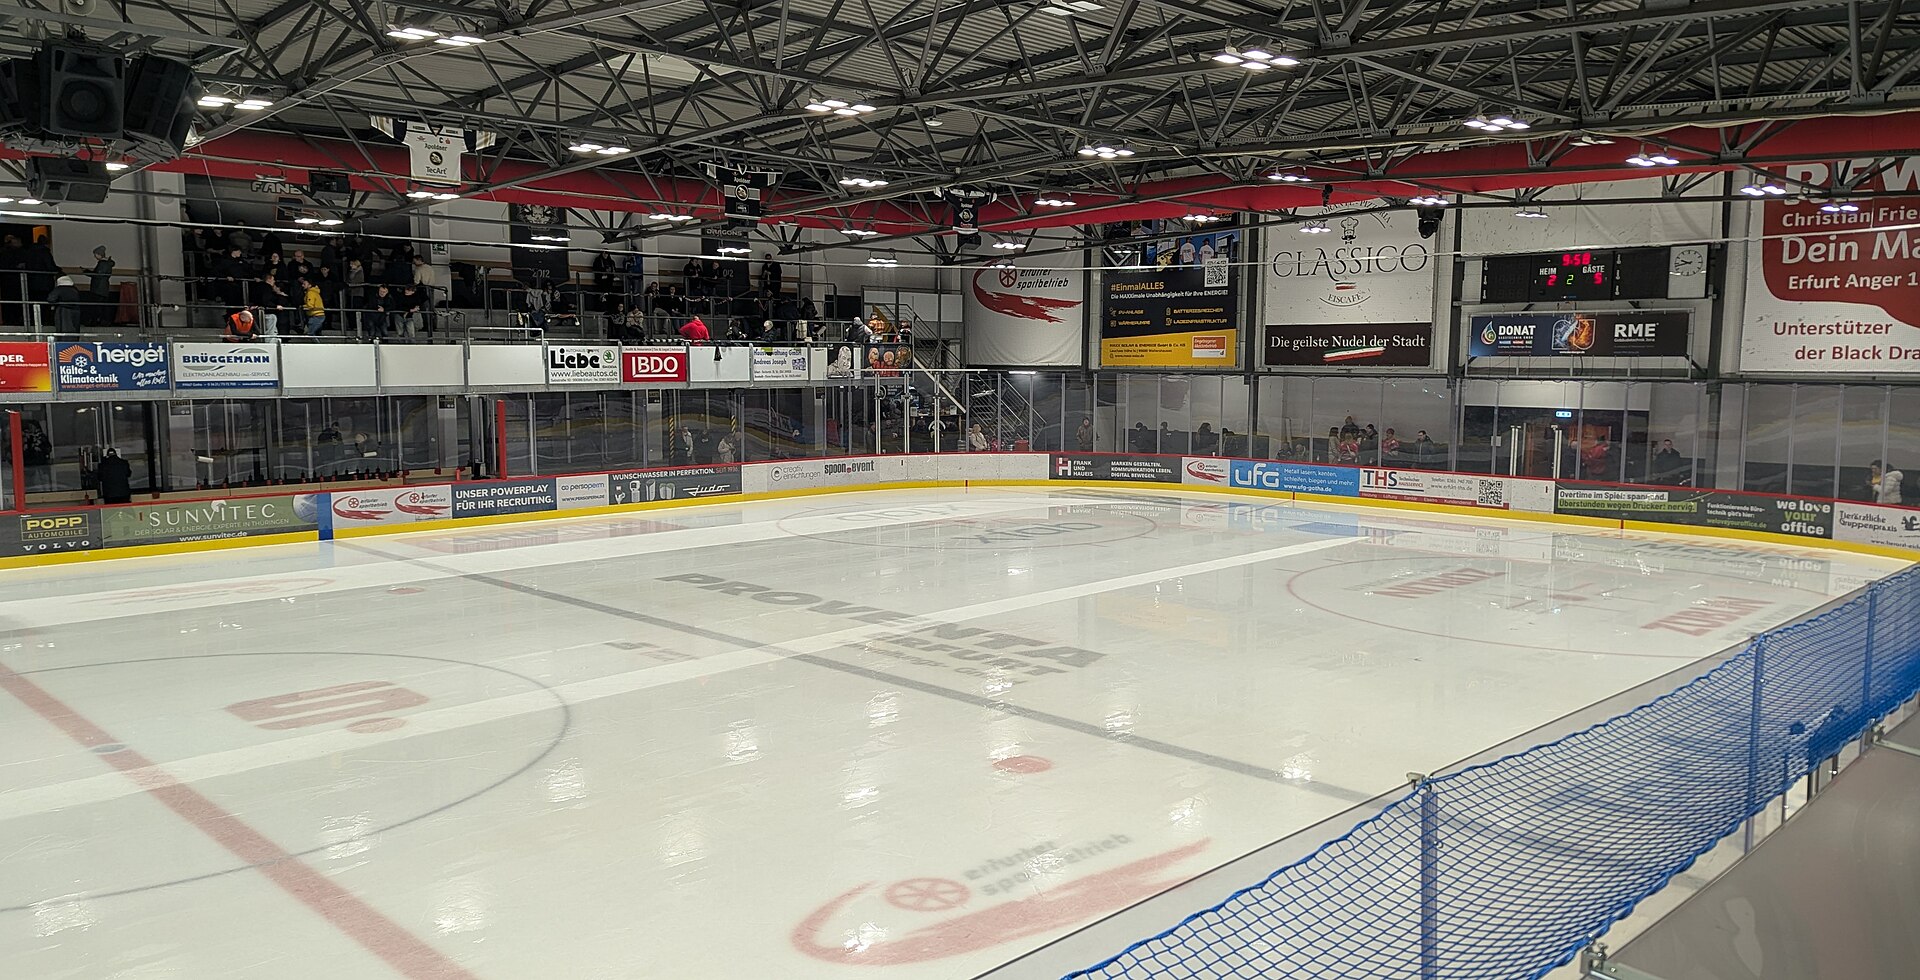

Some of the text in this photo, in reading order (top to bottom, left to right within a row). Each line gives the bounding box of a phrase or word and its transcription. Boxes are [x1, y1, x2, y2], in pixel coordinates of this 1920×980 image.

[1782, 210, 1871, 227] Christian
[1782, 230, 1920, 264] Dein Ma
[1273, 243, 1428, 281] CLASSICO
[1540, 267, 1557, 276] HEIM
[1582, 264, 1605, 274] GÄSTE
[1016, 278, 1069, 290] sportbetrieb
[1547, 275, 1557, 286] 2
[1566, 274, 1574, 284] 2
[1789, 274, 1840, 290] Erfurt
[1845, 273, 1902, 290] Anger
[1110, 282, 1165, 292] #EinmalALLES
[1498, 326, 1536, 336] DONAT
[1614, 324, 1656, 338] RME
[1774, 320, 1893, 336] Unterstützer
[1271, 334, 1426, 351] Die geilste Nudel der Stadt
[97, 343, 165, 367] herget
[182, 352, 270, 363] BRÜGGEMANN
[550, 348, 600, 368] Liebe
[1795, 345, 1920, 360] der Black Dra
[60, 366, 97, 375] Kälte- &
[550, 370, 618, 378] www.liebeautos.de
[60, 374, 119, 384] Klimatechnik
[612, 471, 669, 480] WUNSCHWASSER
[676, 468, 715, 476] PERFEKTION.
[782, 465, 804, 473] creativ
[782, 470, 821, 480] einrichtungen
[1362, 470, 1398, 487] THS
[456, 484, 548, 499] UNSER POWERPLAY
[570, 482, 604, 492] persoperm
[1284, 484, 1332, 492] www.ufg-gotha.de
[456, 495, 554, 510] FÜR IHR RECRUITING.
[1607, 502, 1632, 510] wegen
[1668, 504, 1695, 512] nervig.
[1706, 503, 1750, 512] Funktionierende
[1776, 500, 1830, 514] we love
[149, 503, 276, 527] SUNVITEC
[1784, 510, 1817, 522] your
[1839, 510, 1887, 524] Tierärztliche
[26, 516, 82, 530] POPP
[182, 524, 212, 533] ENERGIE
[213, 522, 242, 531] EXPERTE
[251, 518, 290, 527] THÜRINGEN
[1781, 522, 1825, 536] office
[1840, 518, 1898, 533] Gruppenpraxis
[28, 530, 83, 539] AUTOMOBILE
[179, 530, 248, 542] www.sunvitec.de
[23, 540, 90, 552] VOLVO
